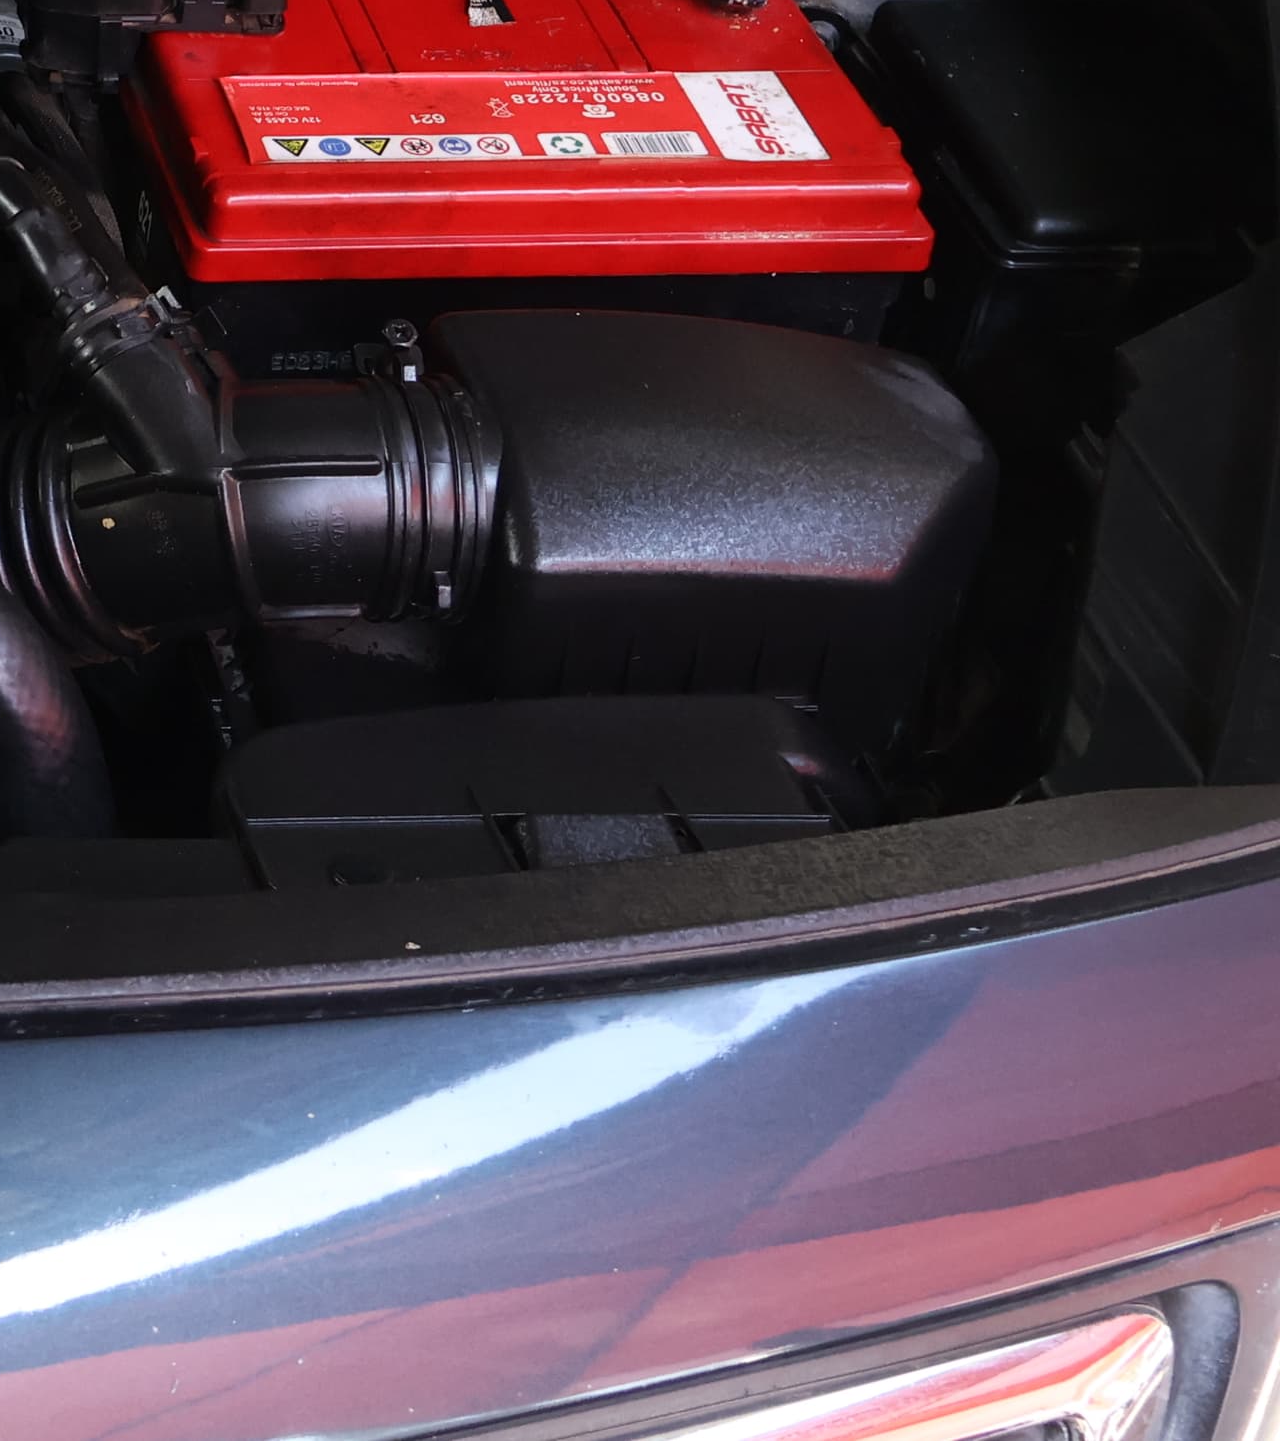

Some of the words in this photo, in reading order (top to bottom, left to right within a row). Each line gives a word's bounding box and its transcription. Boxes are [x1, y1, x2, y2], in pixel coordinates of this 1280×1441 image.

[504, 78, 655, 87] www.sabat.co.za/fitment
[531, 85, 561, 93] Only
[563, 85, 600, 93] Africa
[606, 85, 639, 93] South
[510, 92, 584, 104] 72228
[593, 92, 666, 103] 08600
[253, 116, 263, 124] A
[264, 116, 299, 124] CLASS
[301, 116, 322, 124] 12V
[409, 112, 446, 125] 621
[716, 77, 785, 156] SABAT
